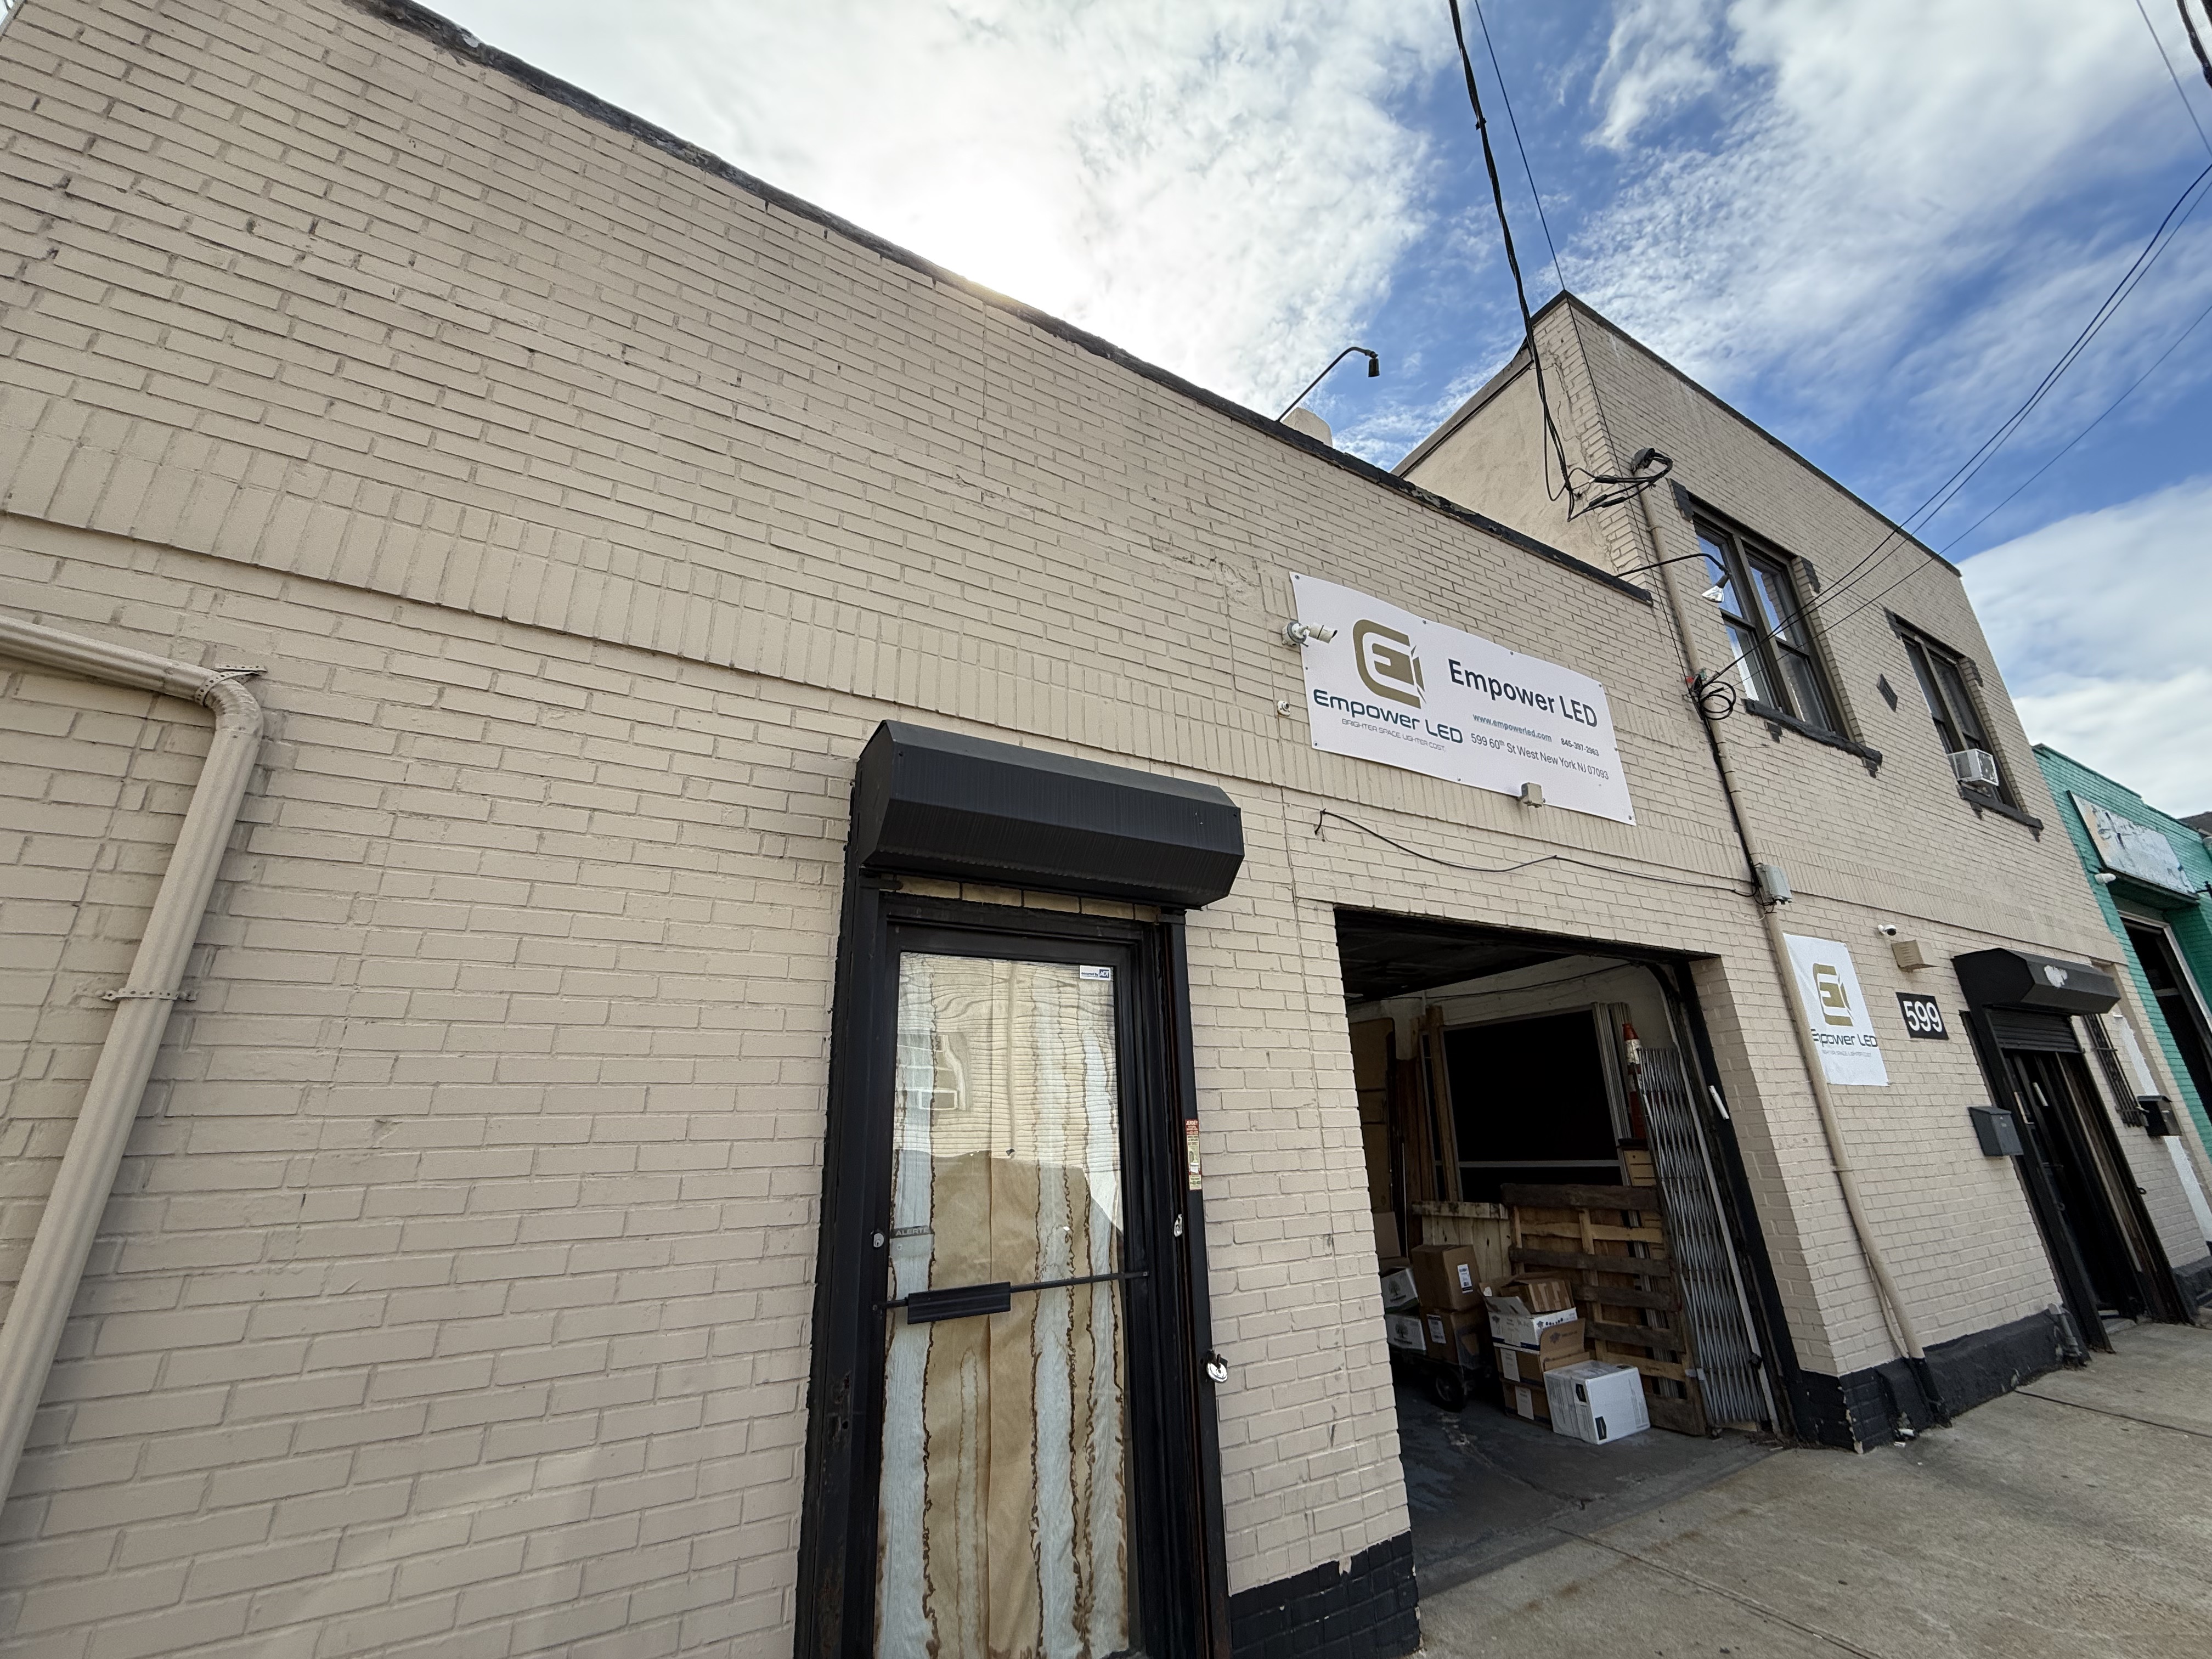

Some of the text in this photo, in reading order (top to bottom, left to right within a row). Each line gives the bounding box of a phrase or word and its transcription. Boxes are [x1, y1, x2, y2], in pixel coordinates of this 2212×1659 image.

[1448, 659, 1598, 727] Empower LED
[1313, 689, 1463, 743] Empower LED
[1342, 719, 1378, 732] BRIGHTER
[1379, 727, 1401, 738] SPACE
[1472, 714, 1552, 742] www.empowerled.com
[1471, 733, 1609, 780] 599 60th St West New York NJ 07093
[1903, 1001, 1942, 1032] 599
[1857, 1034, 1878, 1047] LED
